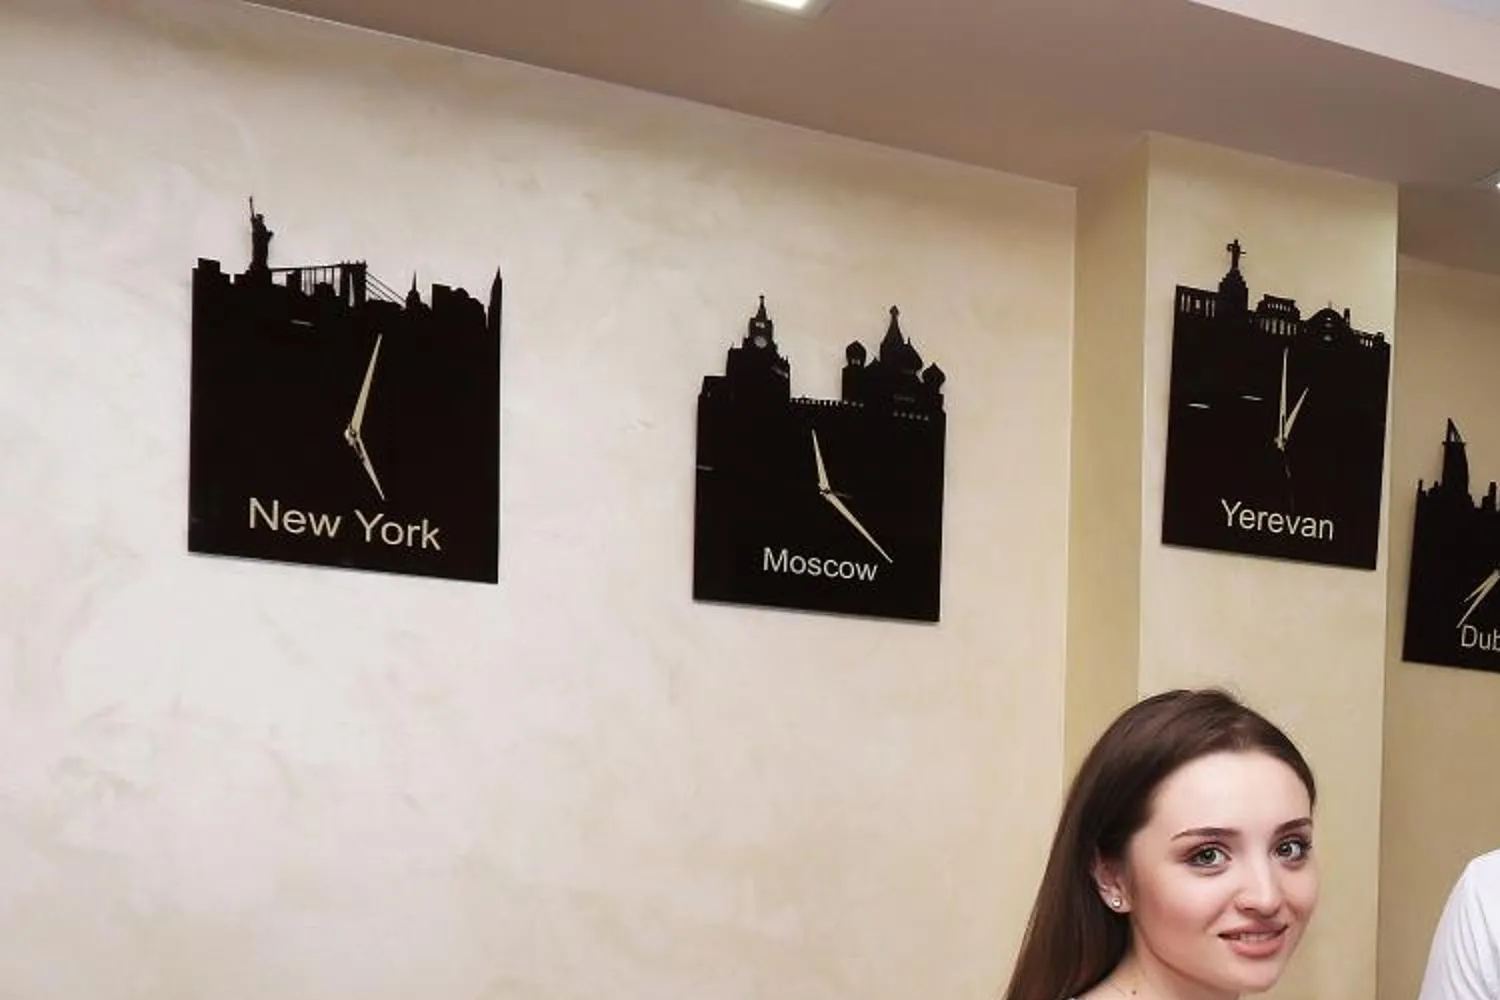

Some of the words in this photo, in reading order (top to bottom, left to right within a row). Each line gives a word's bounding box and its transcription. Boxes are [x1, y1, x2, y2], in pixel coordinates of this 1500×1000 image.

[249, 497, 342, 539] New
[354, 508, 441, 551] York
[1221, 498, 1335, 542] Yerevan
[763, 546, 879, 582] Moscow
